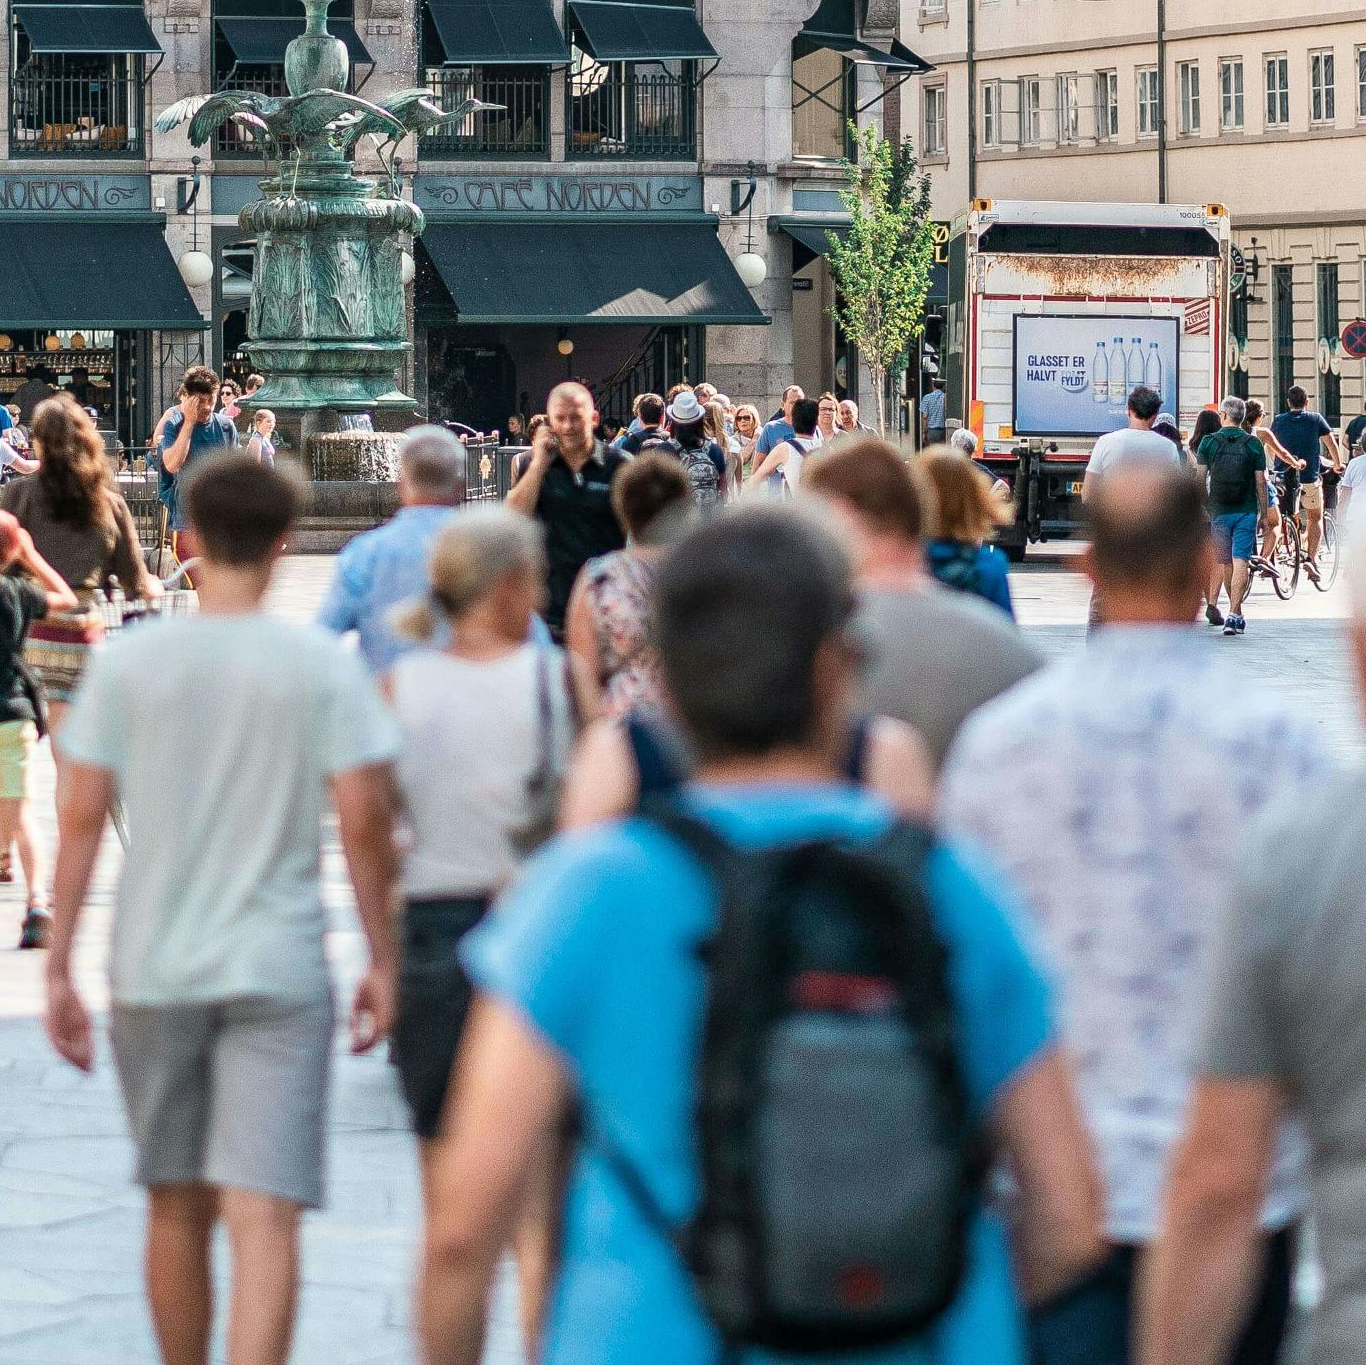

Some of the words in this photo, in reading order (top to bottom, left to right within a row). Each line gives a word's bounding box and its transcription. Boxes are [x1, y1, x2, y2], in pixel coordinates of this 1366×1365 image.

[546, 180, 652, 211] NORDEN
[1027, 355, 1070, 367] GLASSET
[1073, 356, 1085, 367] ER
[1026, 370, 1057, 382] HALVT
[1061, 376, 1085, 386] FYLDT
